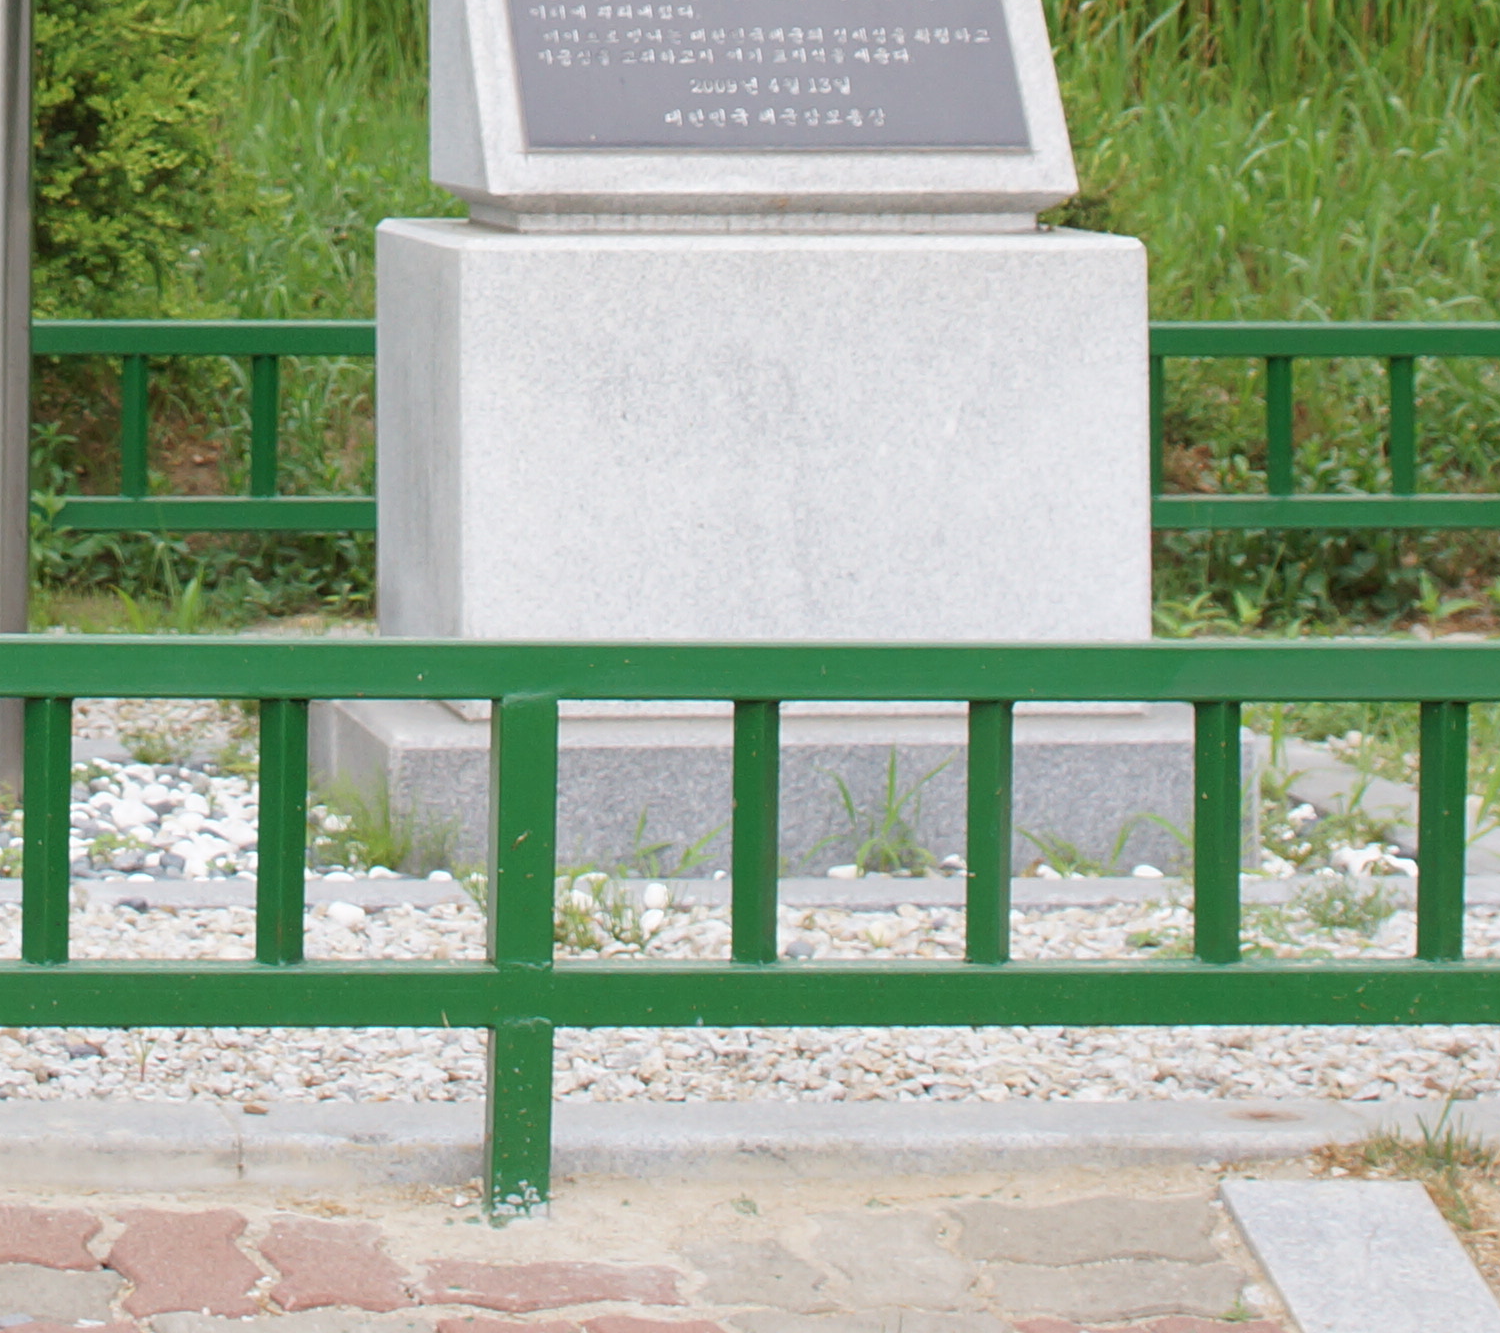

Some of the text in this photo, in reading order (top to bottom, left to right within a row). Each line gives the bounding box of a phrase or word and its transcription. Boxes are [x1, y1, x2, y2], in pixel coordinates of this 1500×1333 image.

[690, 77, 758, 95] 2009년
[809, 76, 850, 94] 13일
[664, 107, 749, 127] 대한민국
